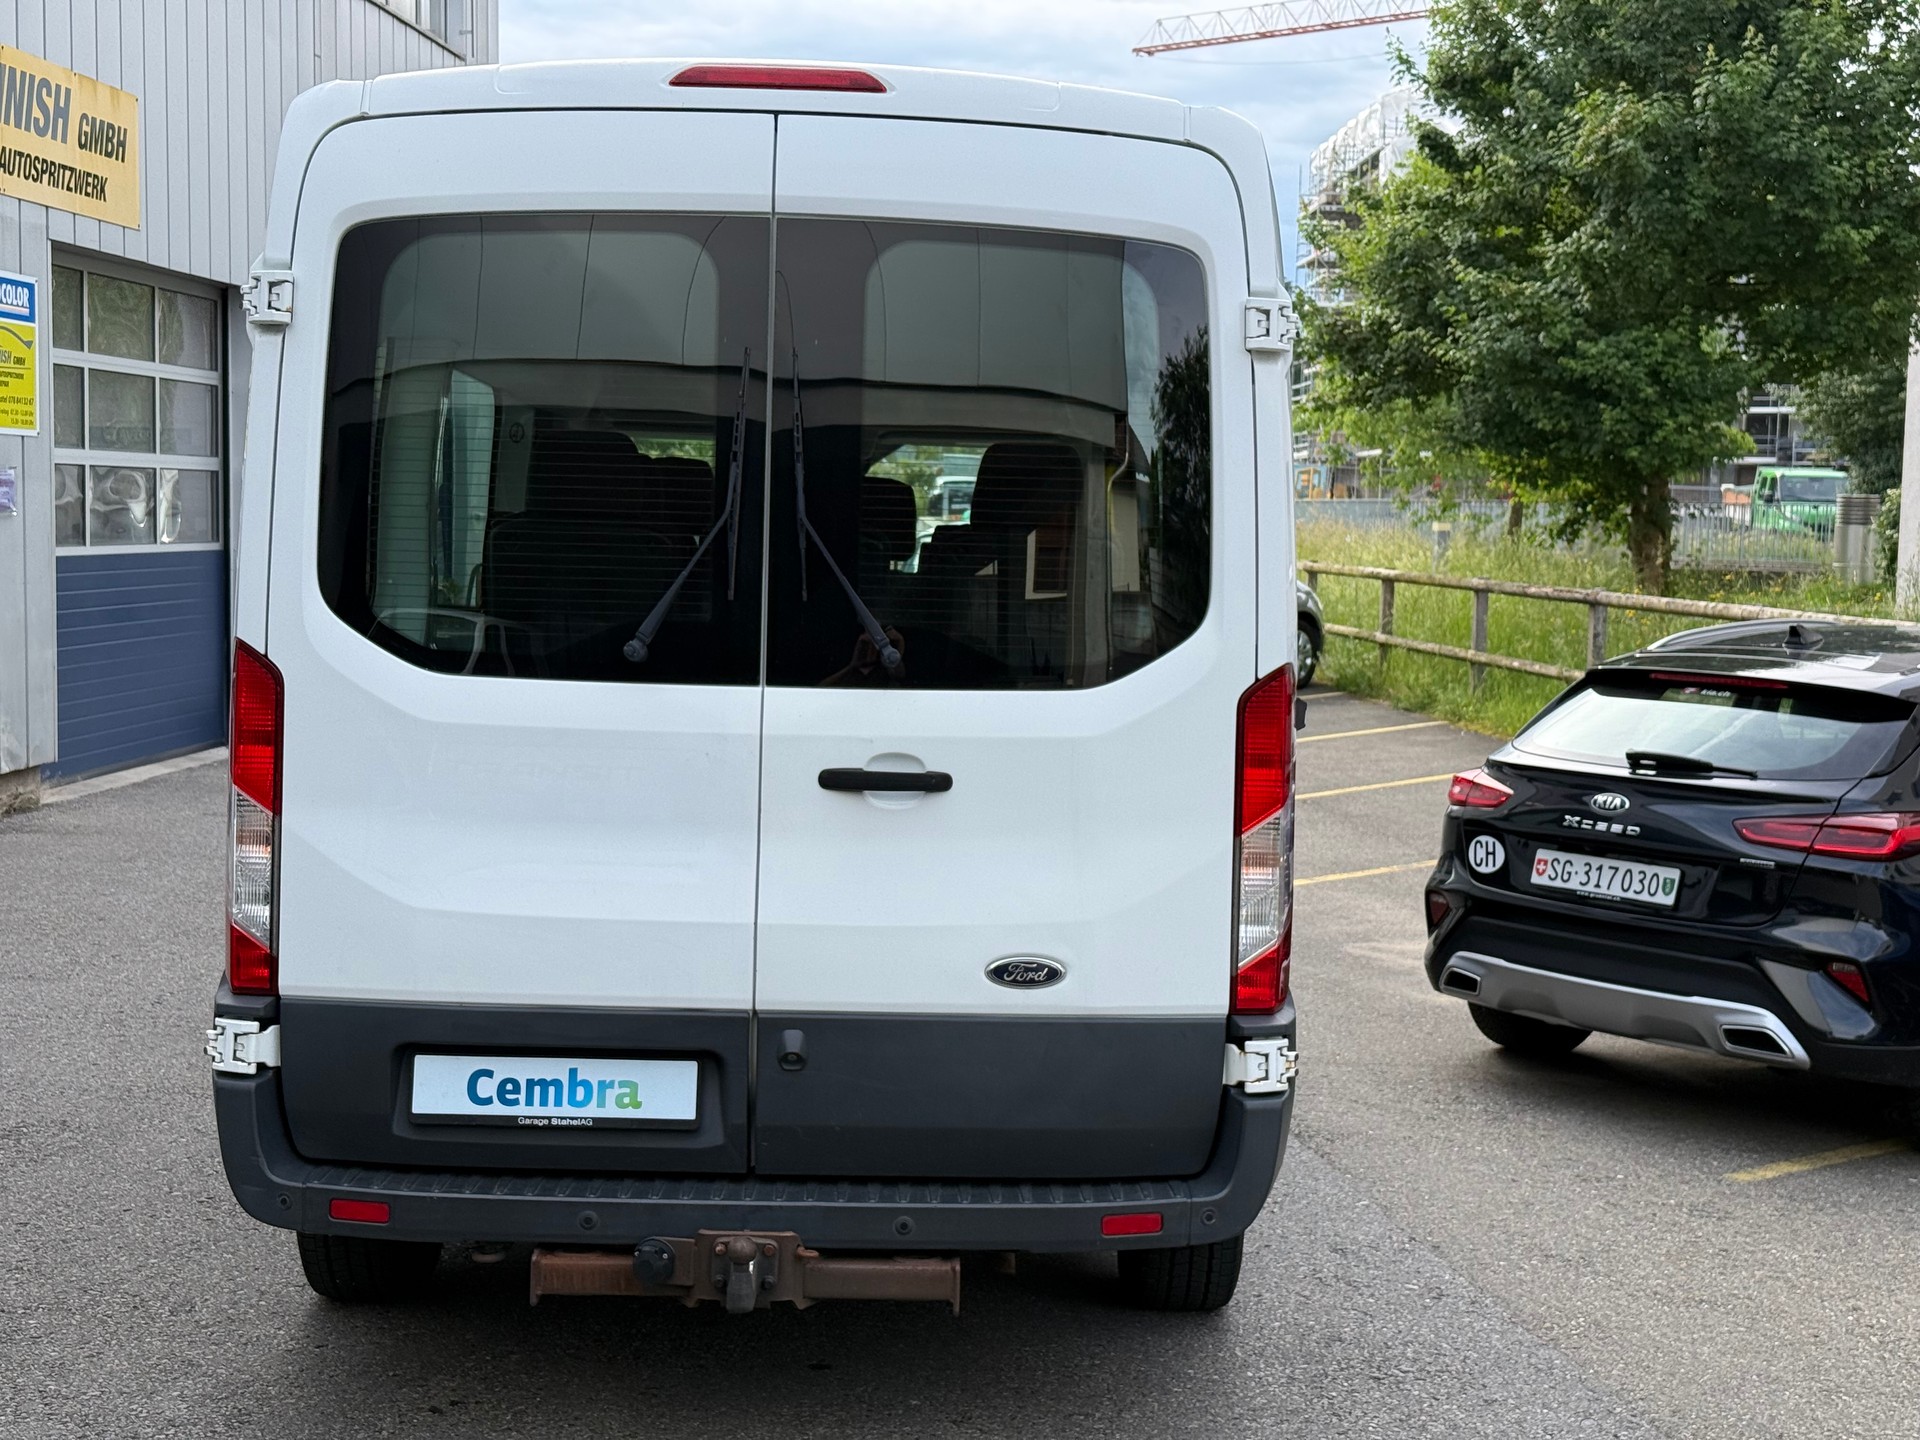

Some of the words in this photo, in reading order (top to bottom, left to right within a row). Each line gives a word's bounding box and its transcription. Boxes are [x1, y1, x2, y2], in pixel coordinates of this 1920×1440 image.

[78, 112, 128, 163] GMBH
[0, 283, 30, 308] COLOR
[1596, 795, 1622, 810] KIA
[1473, 839, 1496, 868] CH
[1003, 962, 1049, 981] Ford
[466, 1067, 643, 1110] Cembra
[517, 1117, 549, 1127] Garage
